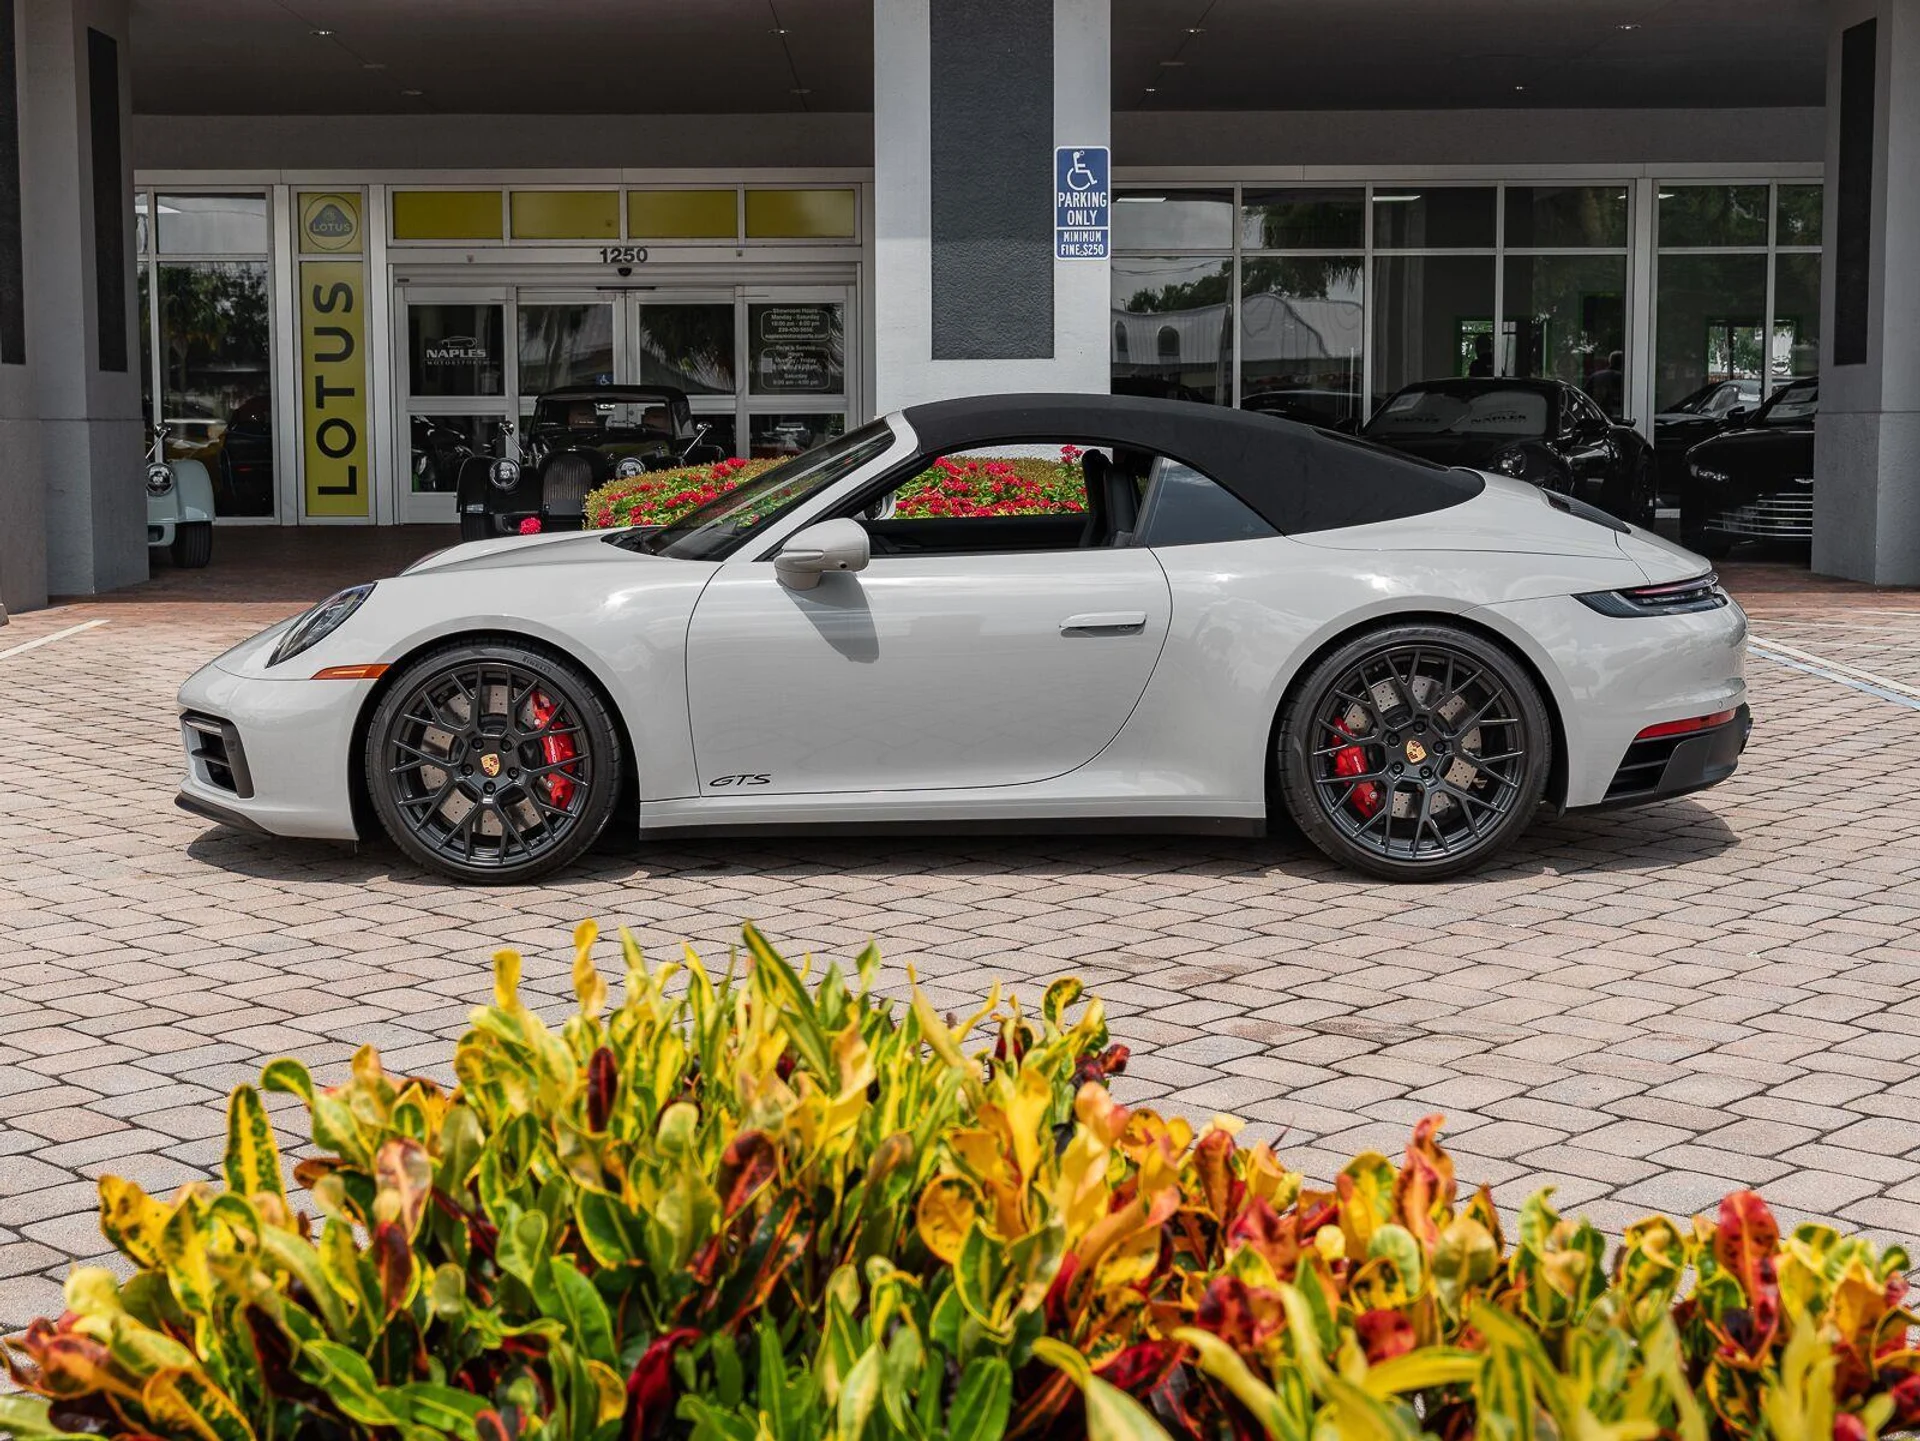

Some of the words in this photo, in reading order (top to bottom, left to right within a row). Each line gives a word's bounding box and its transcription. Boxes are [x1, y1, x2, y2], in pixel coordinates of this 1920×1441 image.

[1058, 192, 1107, 208] PARKING
[1067, 210, 1097, 226] ONLY
[313, 223, 350, 232] LOTUS
[1063, 231, 1102, 242] MINIMUM
[600, 247, 648, 263] 1250
[1061, 244, 1080, 256] FINE
[1083, 244, 1104, 256] $250
[426, 349, 487, 358] NAPLES
[312, 281, 357, 496] LOTUS
[709, 773, 771, 787] GTS
